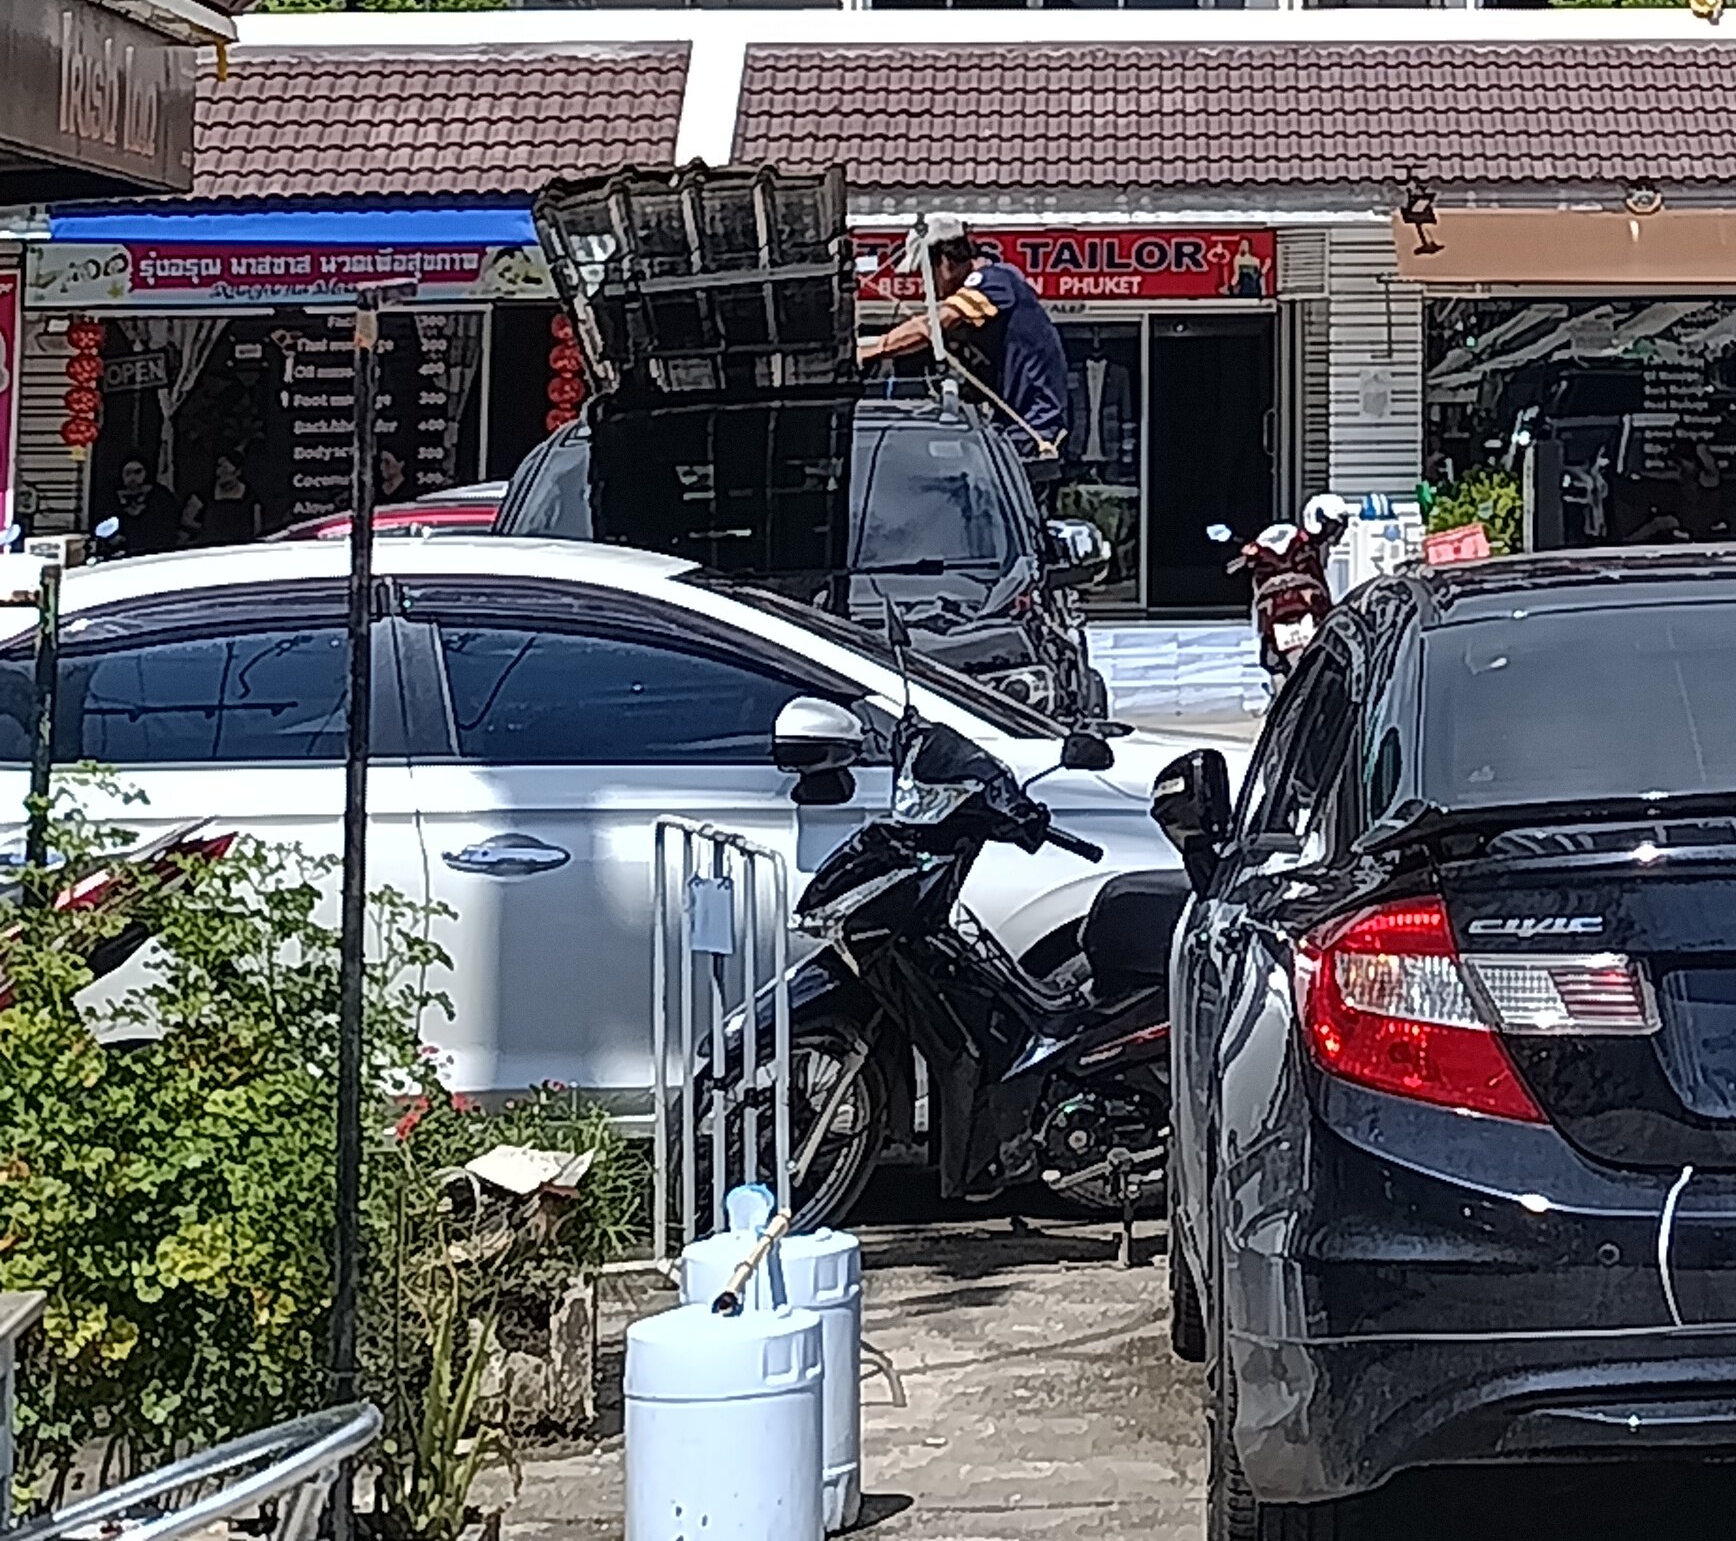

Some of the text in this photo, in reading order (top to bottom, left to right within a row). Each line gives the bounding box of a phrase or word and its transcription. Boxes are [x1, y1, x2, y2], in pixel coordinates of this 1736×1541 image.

[1016, 237, 1208, 273] TAILOR
[879, 277, 926, 296] BEST
[1059, 275, 1142, 296] PHUKET
[106, 354, 164, 386] OPEN
[1467, 915, 1603, 938] CIVIC
